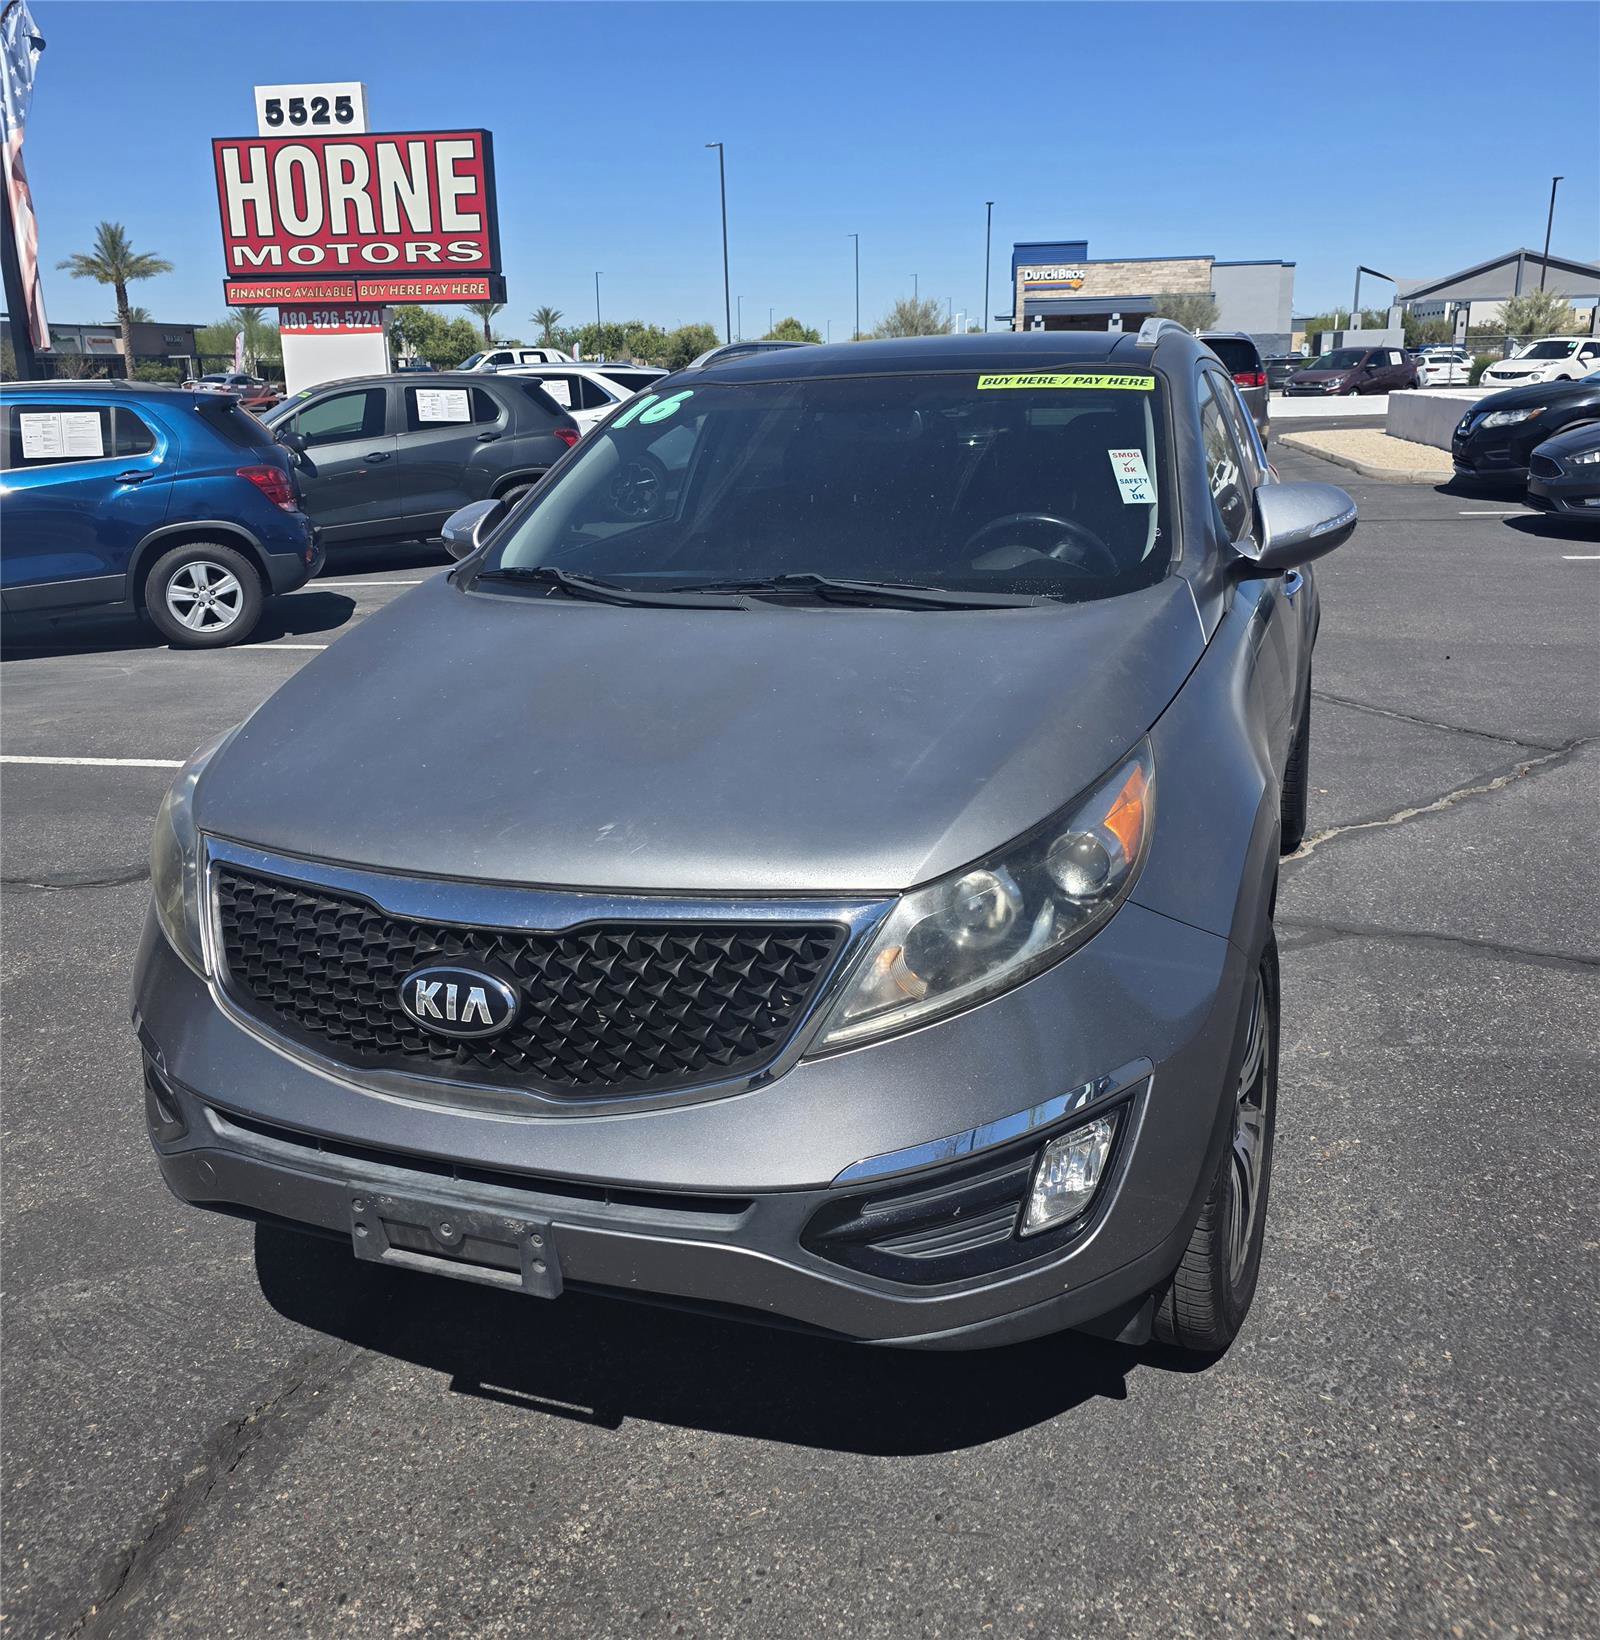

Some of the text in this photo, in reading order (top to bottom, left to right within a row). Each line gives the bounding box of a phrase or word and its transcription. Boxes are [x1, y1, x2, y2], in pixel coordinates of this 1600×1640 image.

[265, 96, 354, 127] 5525
[222, 140, 481, 237] HORNE
[232, 240, 483, 267] MOTORS
[229, 286, 353, 299] FINANCING AVAILABLE
[360, 283, 485, 297] BUY HERE PAY HERE
[281, 310, 380, 329] 480-526-5224
[982, 377, 1013, 386] BUY
[1016, 376, 1058, 385] HERE
[1072, 376, 1104, 385] PAY
[1107, 377, 1149, 387] HERE
[611, 390, 694, 429] 16
[416, 979, 494, 1025] KIA
